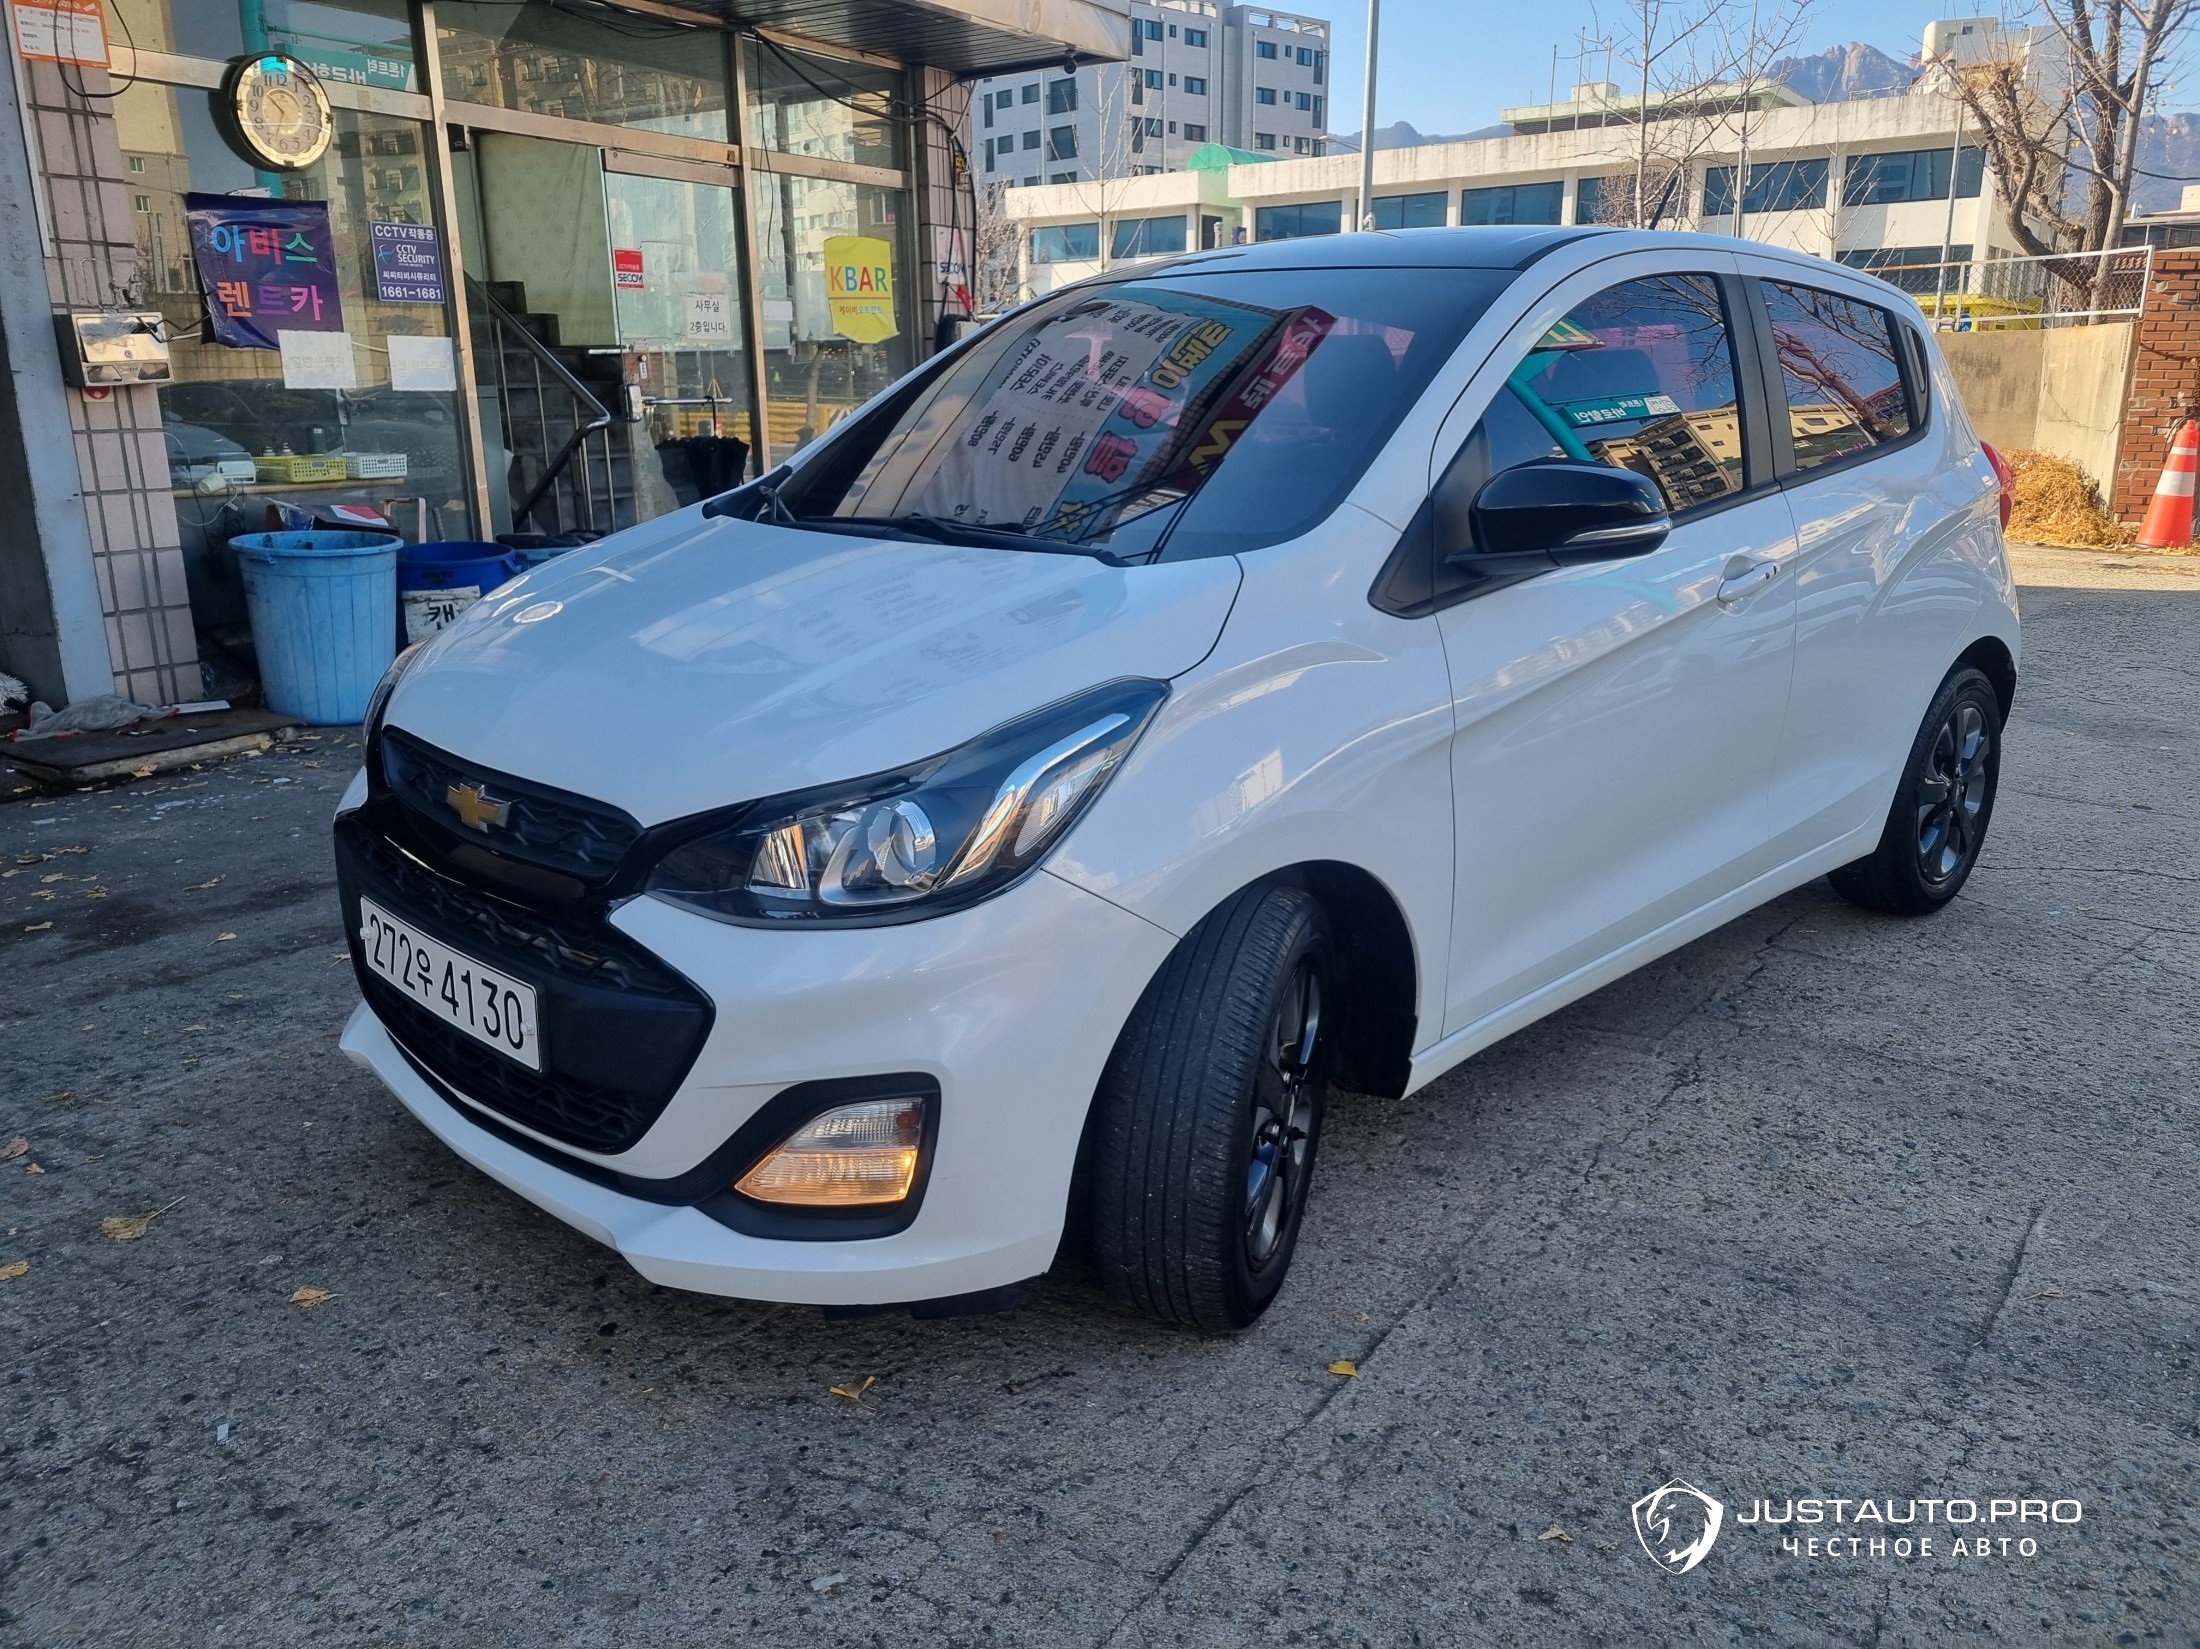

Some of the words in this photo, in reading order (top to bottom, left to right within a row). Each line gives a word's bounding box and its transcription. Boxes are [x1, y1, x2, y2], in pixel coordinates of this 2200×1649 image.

[276, 74, 288, 86] 12
[252, 85, 264, 97] 10
[250, 100, 258, 112] 9
[303, 95, 312, 108] 2
[212, 225, 318, 265] 아비스
[396, 244, 417, 254] CCTV
[398, 254, 435, 264] SECURITY
[618, 273, 644, 284] SECOM
[830, 266, 888, 292] KBAR
[382, 286, 441, 300] 1661-1681
[217, 281, 324, 321] 렌트카
[696, 300, 720, 312] 사무실
[690, 322, 728, 333] 2층입니다.
[370, 913, 433, 997] 272우
[441, 960, 524, 1050] 4130
